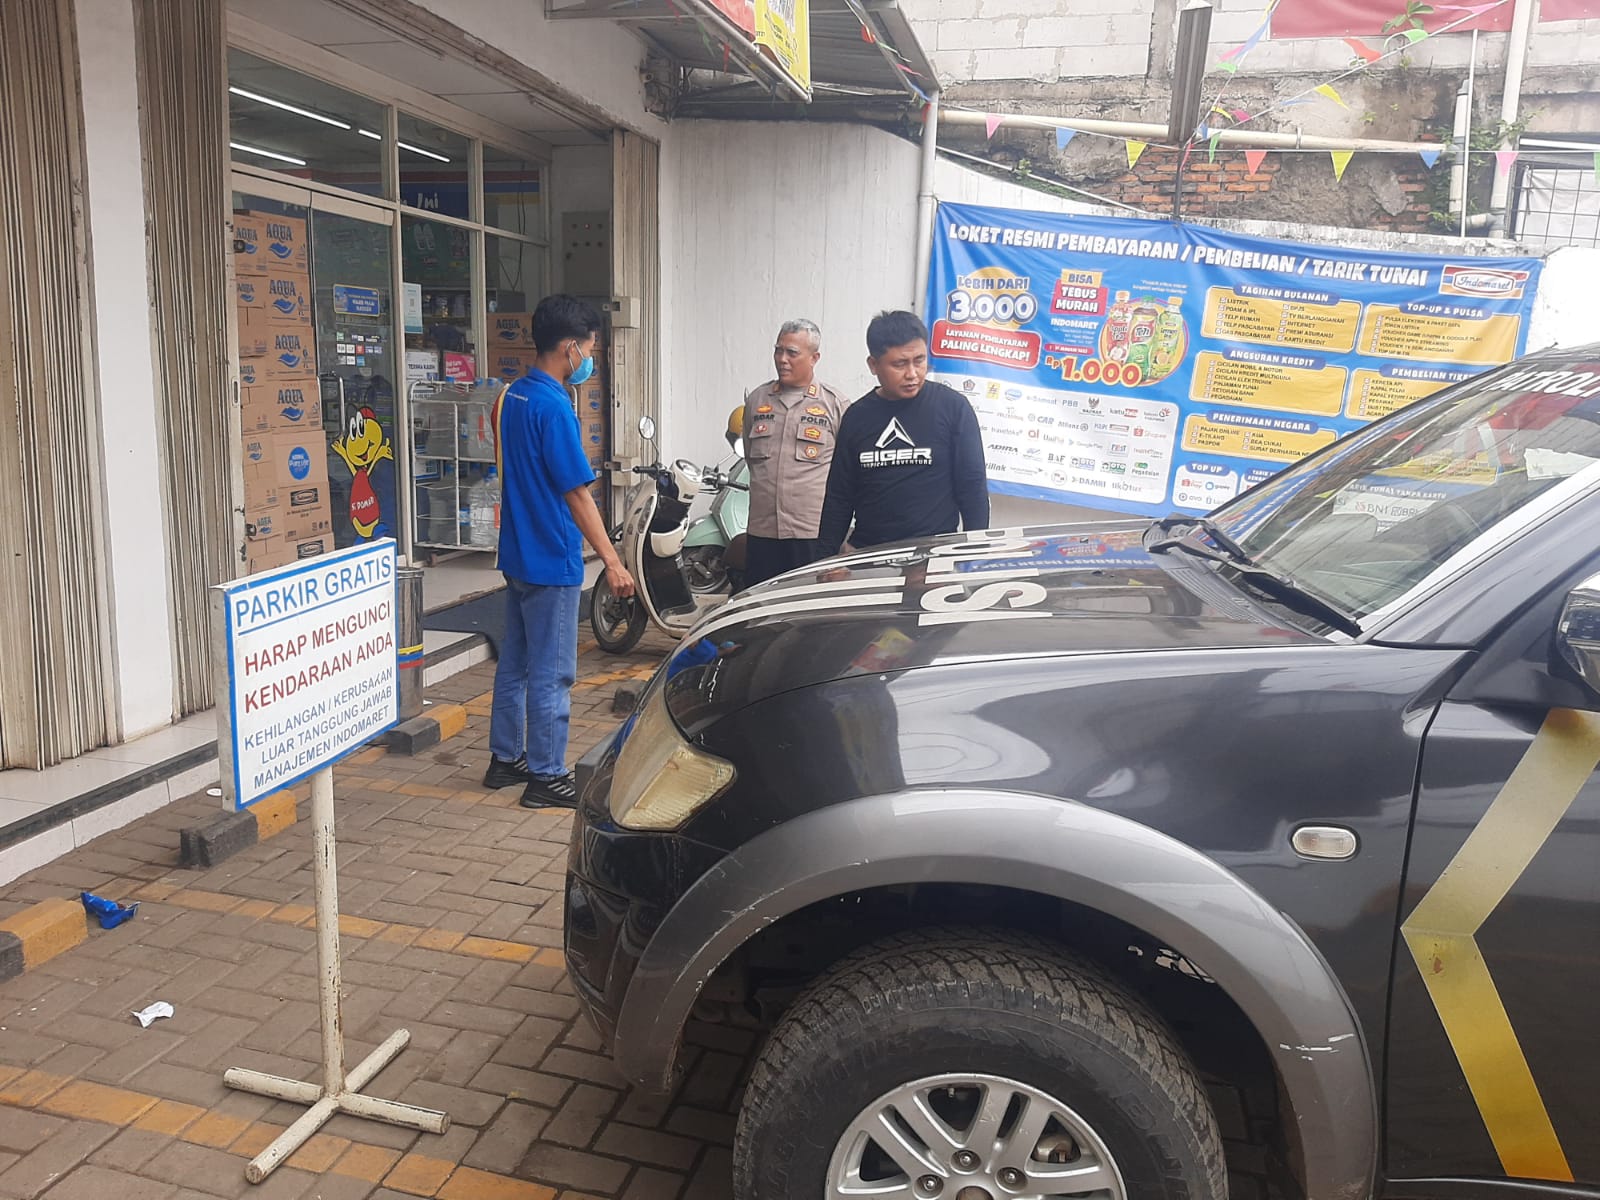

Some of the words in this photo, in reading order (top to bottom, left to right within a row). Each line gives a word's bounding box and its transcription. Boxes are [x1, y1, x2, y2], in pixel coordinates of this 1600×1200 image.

[236, 227, 258, 242] AQUA
[266, 222, 293, 243] AQUA
[949, 223, 1000, 243] LOKET
[1002, 230, 1054, 249] RESMI
[1058, 233, 1178, 260] PEMBAYARAN
[1180, 245, 1192, 261] /
[1193, 246, 1296, 274] PEMBELIAN
[1298, 257, 1309, 275] /
[1312, 261, 1368, 282] TARIK
[1370, 265, 1429, 287] TUNAI
[997, 277, 1029, 290] DARI
[1068, 274, 1093, 285] BISA
[1457, 275, 1511, 290] Indomaret
[269, 279, 296, 299] AQUA
[1061, 286, 1097, 299] TEBUS
[1241, 285, 1282, 298] TAGIHAN
[1284, 289, 1329, 302] BULANAN
[949, 289, 1036, 323] 3.000
[1056, 299, 1098, 313] MURAH
[1407, 302, 1442, 314] TOP-UP
[1453, 308, 1483, 318] PULSA
[496, 318, 520, 331] AQUA
[275, 334, 301, 352] AQUA
[945, 329, 980, 341] LAYANAN
[980, 333, 1028, 349] PEMBAYARAN
[940, 339, 983, 354] PALING
[983, 344, 1030, 362] LENGKAP!
[1230, 350, 1280, 362] ANGSURAN
[1282, 356, 1314, 366] KREDIT
[1046, 355, 1060, 369] Rp
[1062, 356, 1141, 386] 1.000
[1392, 368, 1446, 379] PEMBELIAN
[1448, 372, 1475, 381] TIKE
[277, 388, 304, 406] AQUA
[800, 416, 828, 426] POLRI
[1212, 413, 1274, 429] PENERIMAAN
[1277, 418, 1310, 431] NEGARA
[860, 448, 932, 463] EIGER
[1191, 463, 1208, 472] TOP
[1367, 504, 1388, 514] BNI
[236, 579, 318, 628] PARKIR
[324, 555, 391, 597] GRATIS
[245, 634, 307, 676] HARAP
[312, 600, 391, 650] MENGUNCI
[245, 653, 353, 714] KENDARAAN
[356, 631, 393, 665] ANDA
[244, 700, 326, 752] KEHILANGAN
[328, 695, 332, 712] /
[333, 666, 393, 708] KERUSAKAN
[261, 739, 295, 765] LUAR
[298, 707, 359, 750] TANGGUNG
[360, 685, 392, 714] JAWAB
[254, 741, 331, 789] MANAJEMEN
[333, 704, 389, 749] INDOMARET
